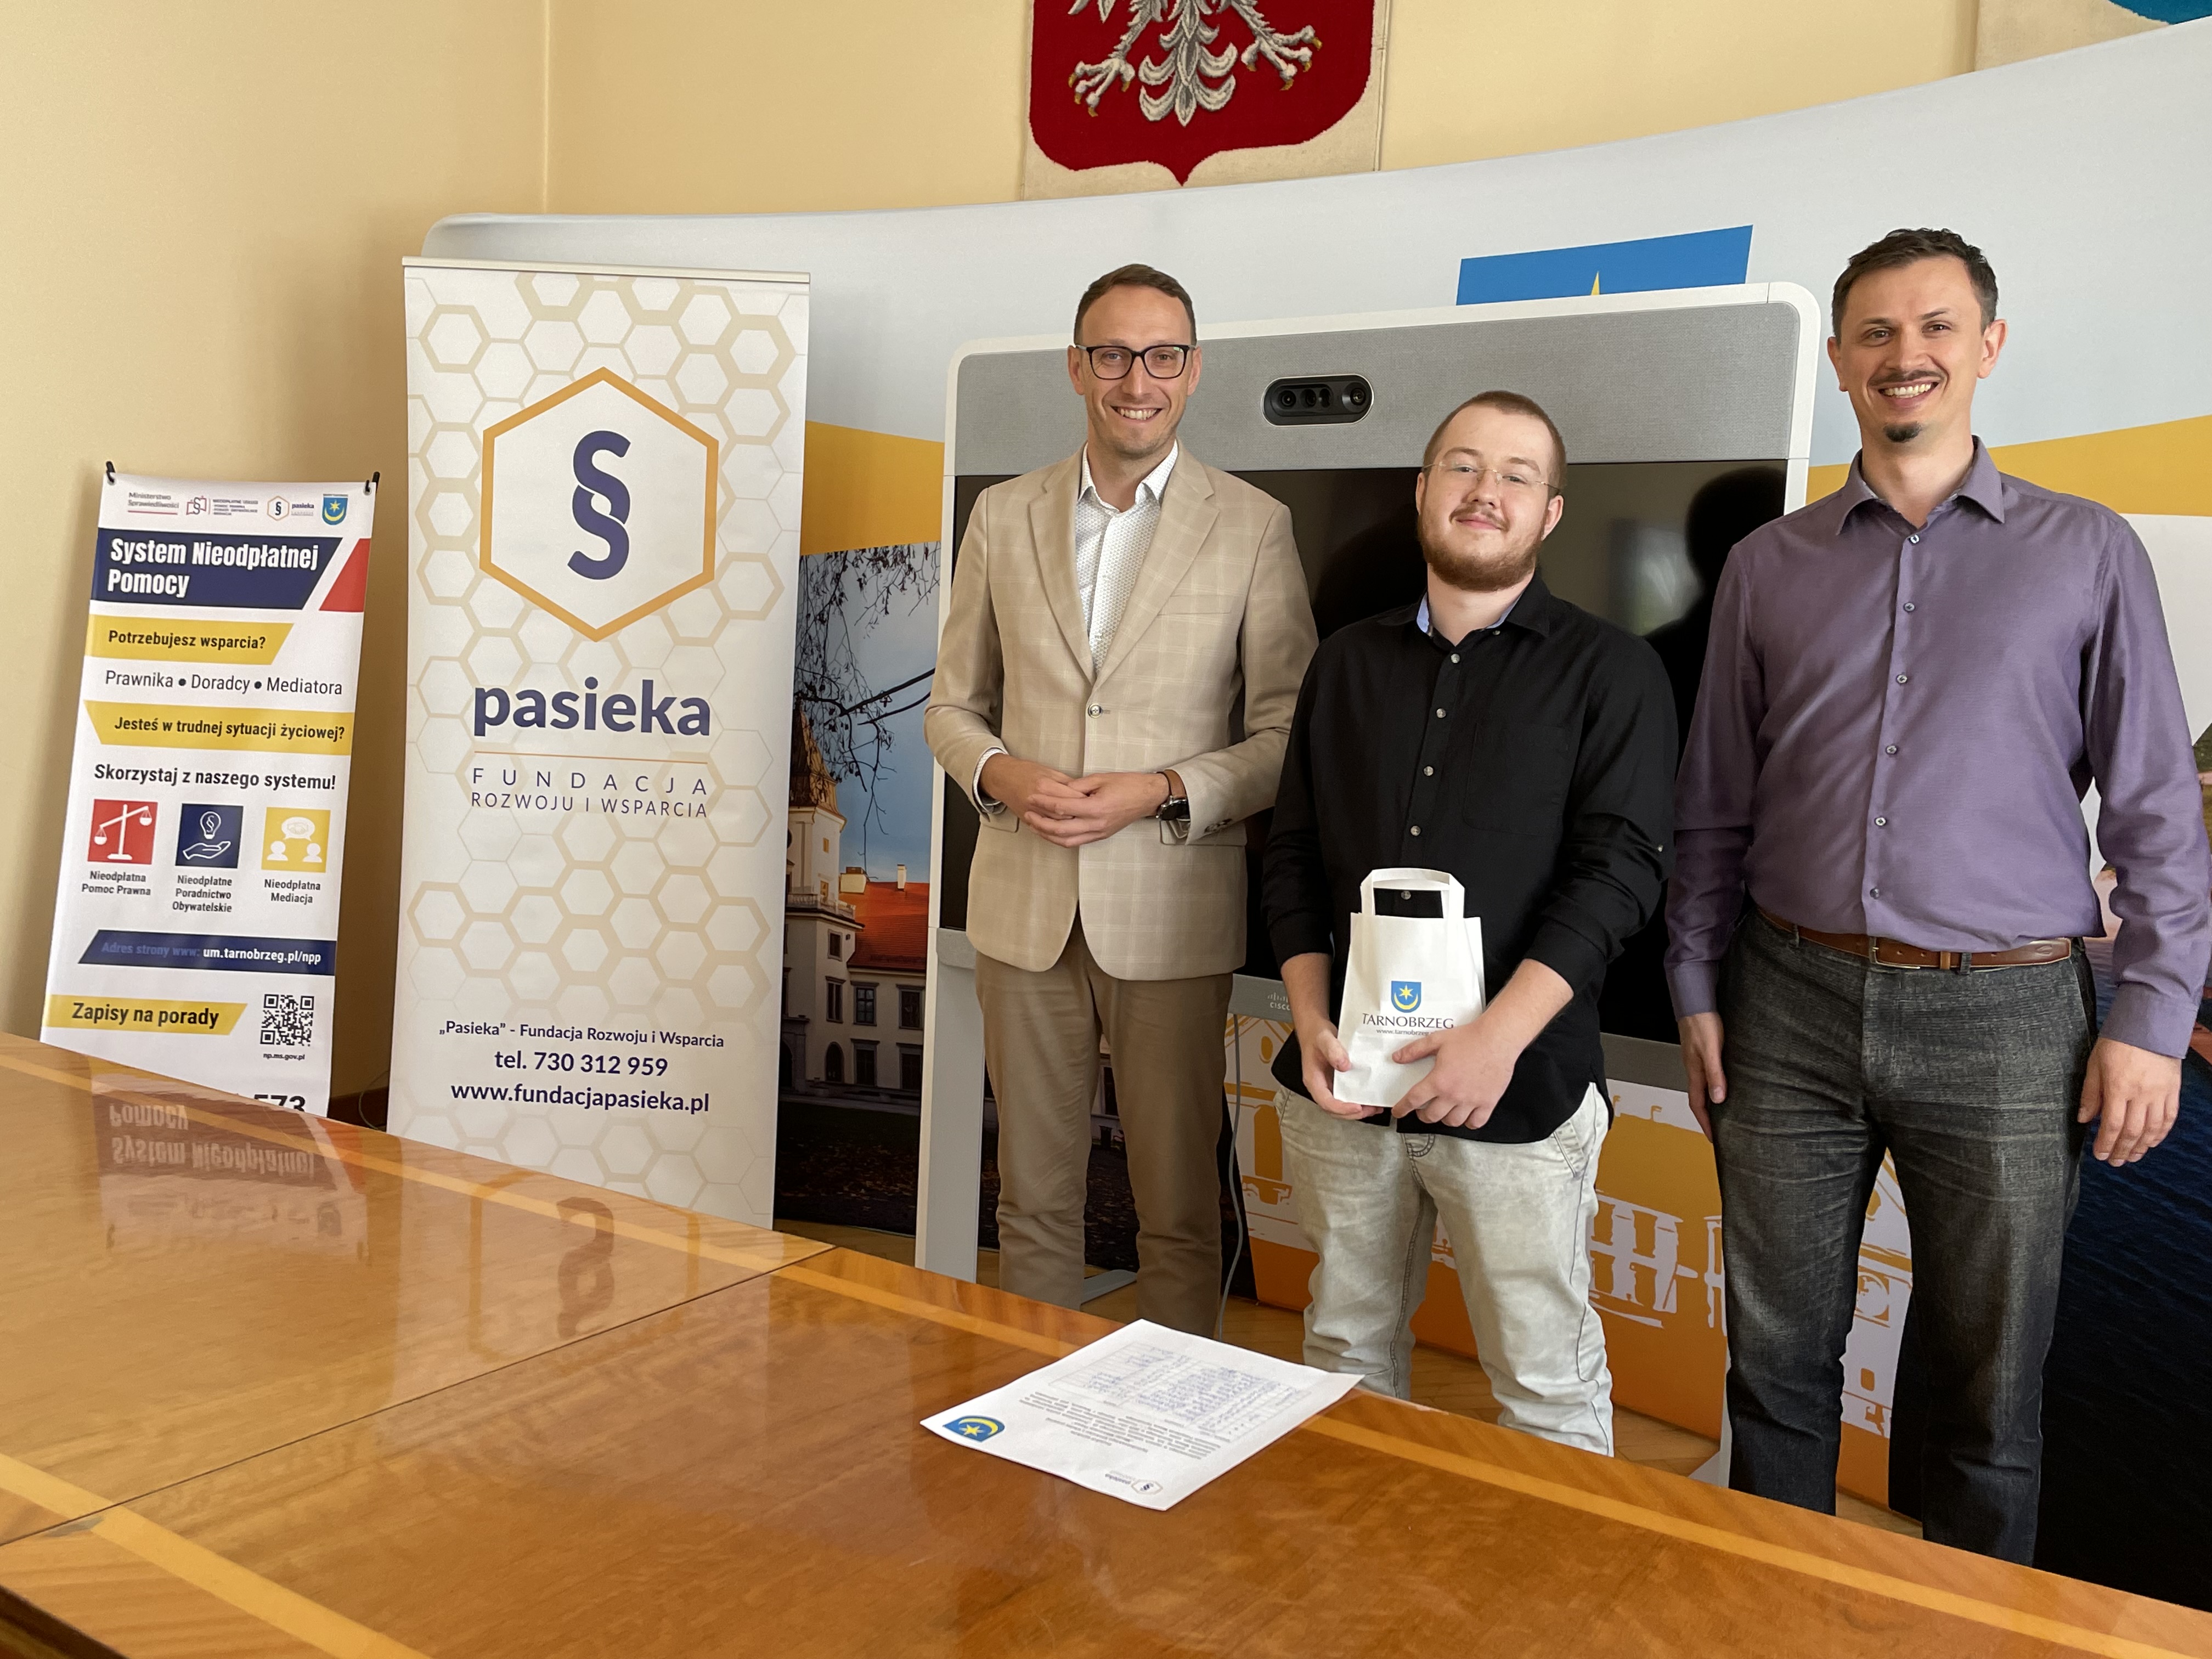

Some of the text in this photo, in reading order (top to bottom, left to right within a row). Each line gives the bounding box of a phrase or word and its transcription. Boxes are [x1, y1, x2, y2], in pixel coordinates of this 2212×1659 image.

[128, 500, 179, 509] Sprawiedliwości
[110, 538, 318, 571] System Nieodpłatnej
[108, 569, 190, 599] Pomocy
[109, 630, 266, 650] Potrzebujesz wsparcia?
[106, 670, 342, 695] Prawnika Doradcy Mediatora
[473, 676, 711, 737] pasieka
[115, 716, 345, 741] Jesteś w trudnej sytuacji życiowej?
[94, 764, 336, 791] Skorzystaj z naszego systemu!
[472, 767, 707, 795] FUNDACJA
[471, 792, 707, 818] ROZWOJU I WSPARCIA
[82, 884, 151, 896] Pomoc Prawna
[90, 871, 146, 884] Nieodpłatna
[177, 875, 233, 888] Nieodpłatne
[264, 879, 320, 892] Nieodpłatna
[176, 889, 232, 900] Poradnictwo
[270, 893, 313, 905] Mediacja
[172, 902, 232, 914] Obywatelskie
[101, 942, 321, 965] Adres strony www: um.tarnobrzeg.pl/npp
[71, 1002, 219, 1030] Zapisy na porady
[1362, 1013, 1454, 1029] TARNOBRZEG
[439, 1020, 506, 1036] „Pasieka”
[520, 1024, 583, 1041] Fundacja
[587, 1026, 647, 1044] Rozwoju
[651, 1030, 656, 1043] i
[659, 1031, 724, 1049] Wsparcia
[494, 1050, 668, 1077] tel. 730 312 959
[451, 1082, 710, 1114] www.fundacjapasieka.pl
